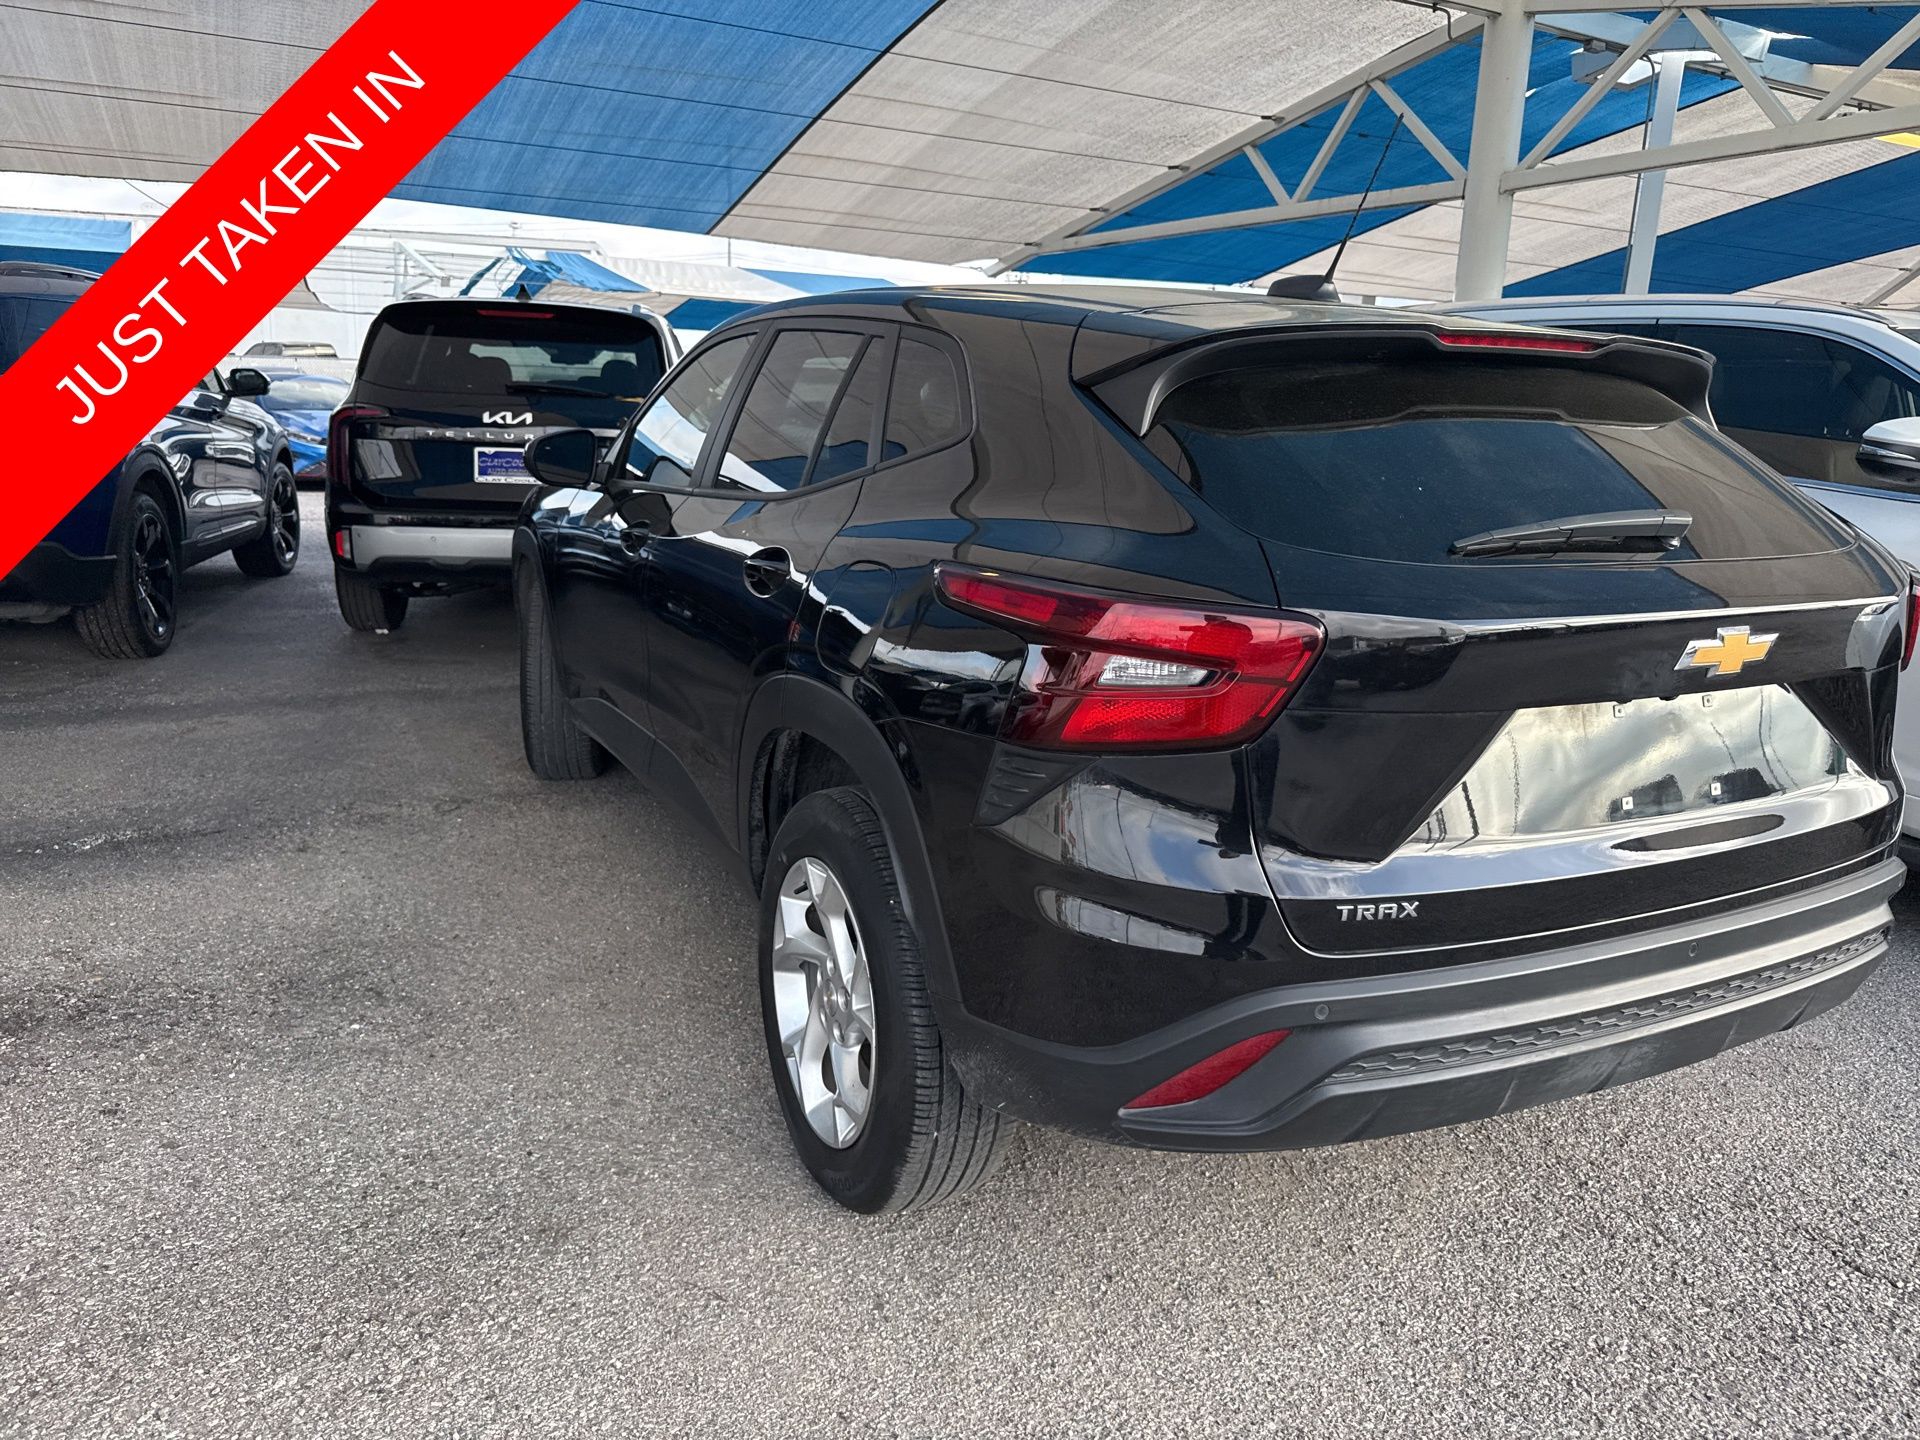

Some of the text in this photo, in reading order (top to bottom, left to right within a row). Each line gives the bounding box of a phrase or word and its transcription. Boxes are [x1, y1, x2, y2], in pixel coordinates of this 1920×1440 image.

[482, 411, 533, 425] KIA
[426, 430, 535, 440] TELLUR
[1336, 901, 1420, 922] TRAX
